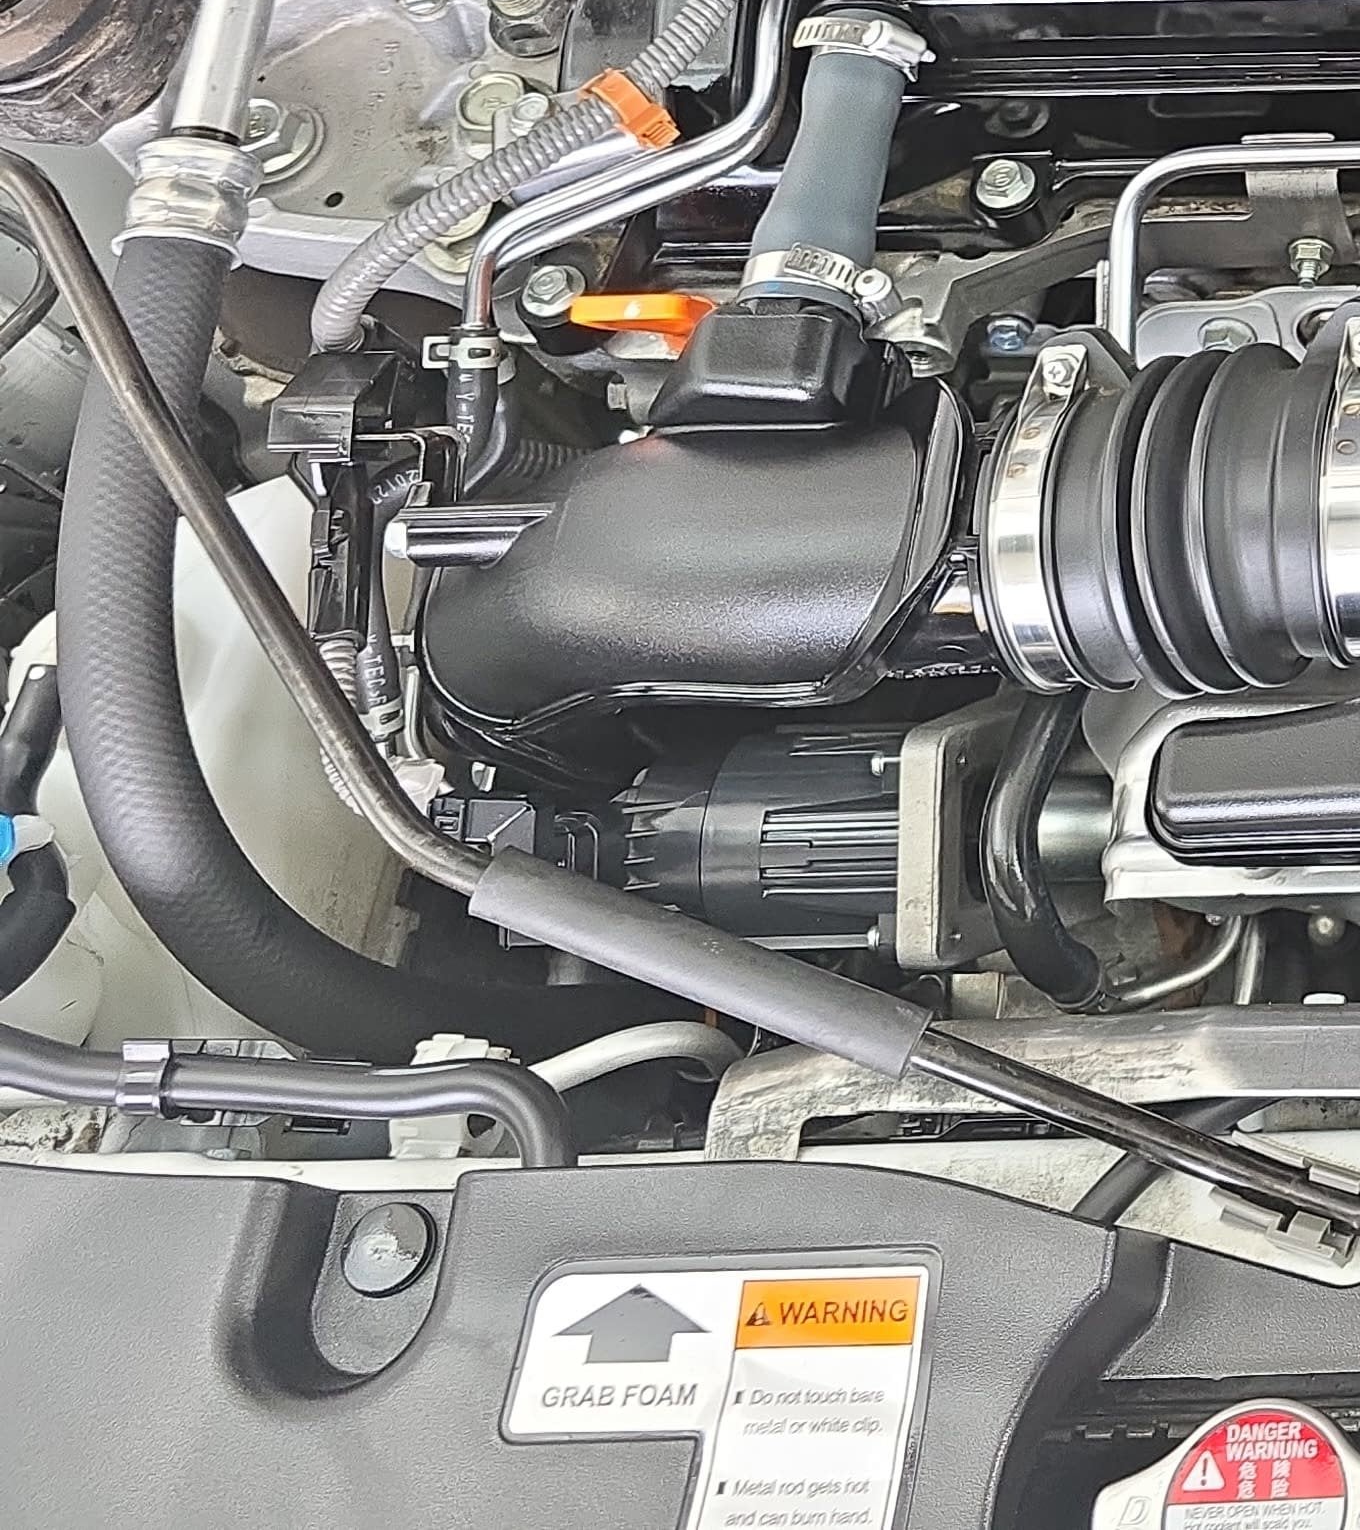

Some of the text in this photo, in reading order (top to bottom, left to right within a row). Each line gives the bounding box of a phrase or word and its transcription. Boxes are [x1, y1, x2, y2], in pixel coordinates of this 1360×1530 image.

[780, 1299, 909, 1326] WARNING
[542, 1382, 699, 1408] GRAB FOAM
[749, 1387, 885, 1406] Do not touch bare
[742, 1419, 786, 1436] metal
[789, 1422, 807, 1435] or
[809, 1418, 850, 1435] white
[1226, 1421, 1302, 1443] DANGER
[1226, 1440, 1319, 1461] WARNUNG
[732, 1477, 870, 1498] Metal rod gets hot
[725, 1510, 755, 1527] and
[760, 1512, 790, 1526] can
[792, 1509, 826, 1526] burn
[1185, 1505, 1226, 1520] NEVER
[1227, 1503, 1261, 1518] OPEN
[1263, 1502, 1298, 1517] WHEN
